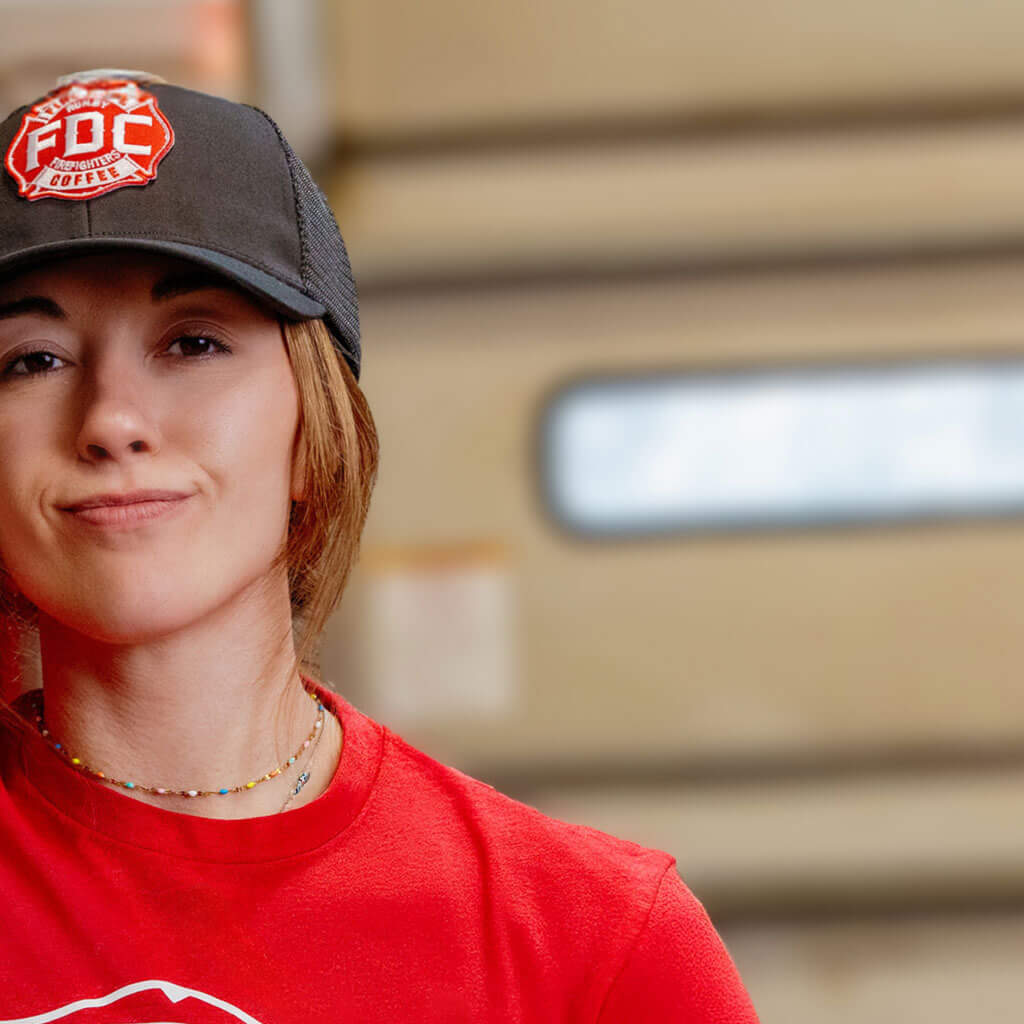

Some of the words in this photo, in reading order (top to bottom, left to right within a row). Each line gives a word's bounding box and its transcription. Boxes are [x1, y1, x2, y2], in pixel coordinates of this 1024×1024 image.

[25, 111, 153, 173] FDC
[50, 150, 121, 171] FIREFIGHTERS
[50, 166, 120, 186] COFFEE
